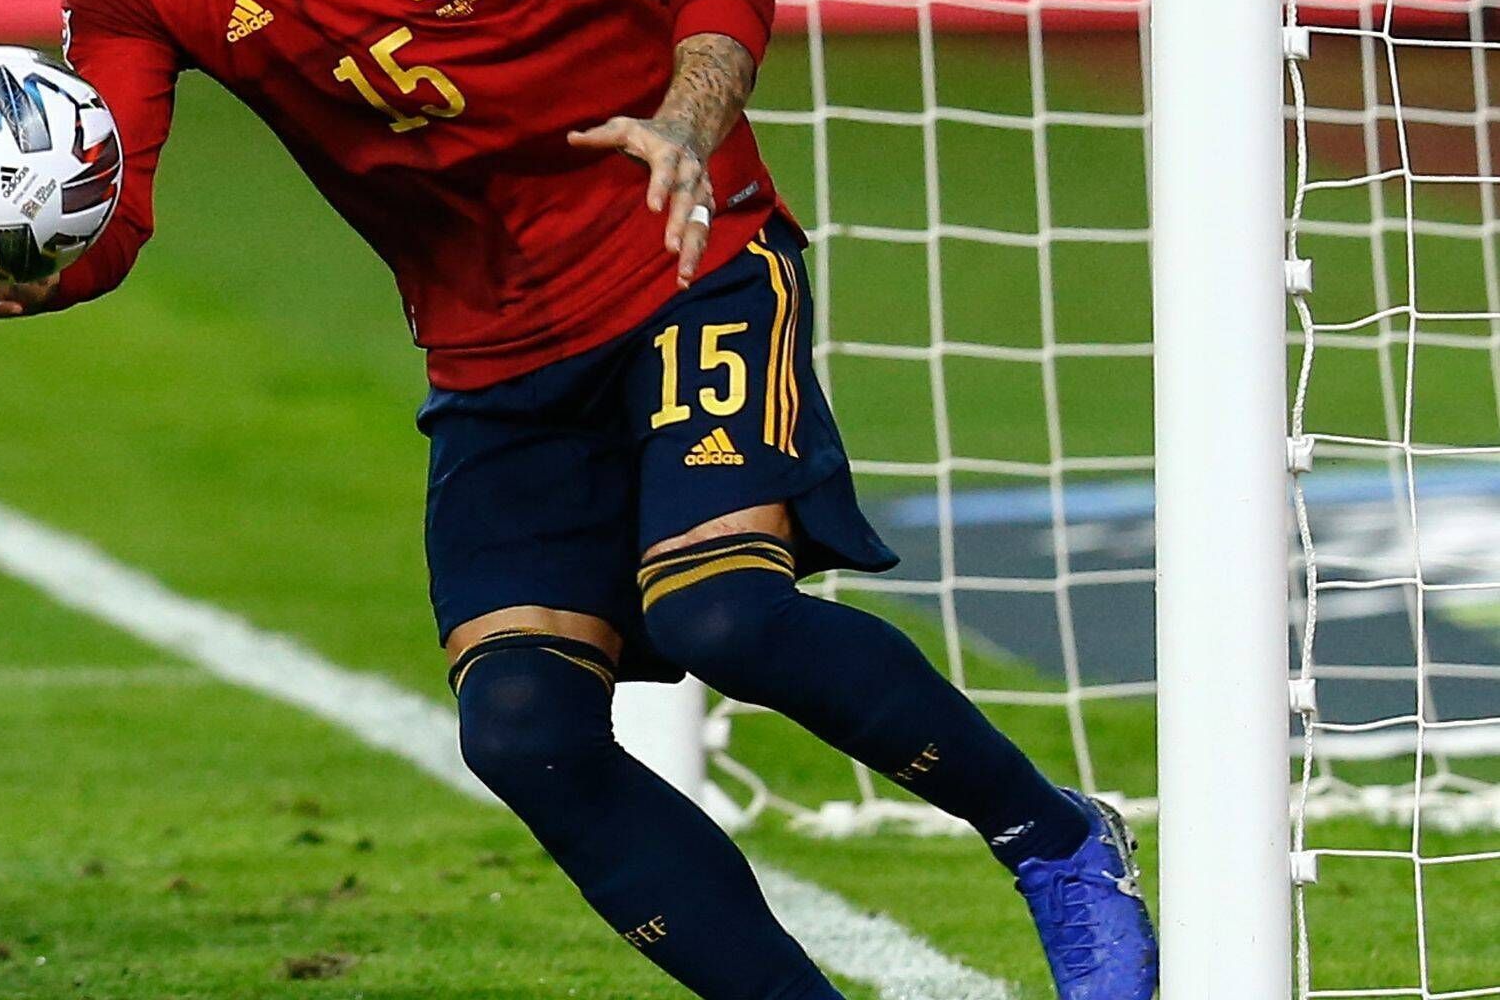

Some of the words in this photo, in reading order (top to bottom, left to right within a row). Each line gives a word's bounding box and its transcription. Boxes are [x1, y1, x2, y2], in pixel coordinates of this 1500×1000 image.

[226, 9, 275, 43] adidas
[332, 25, 466, 133] 15
[650, 321, 749, 430] 15
[683, 450, 745, 466] adidas
